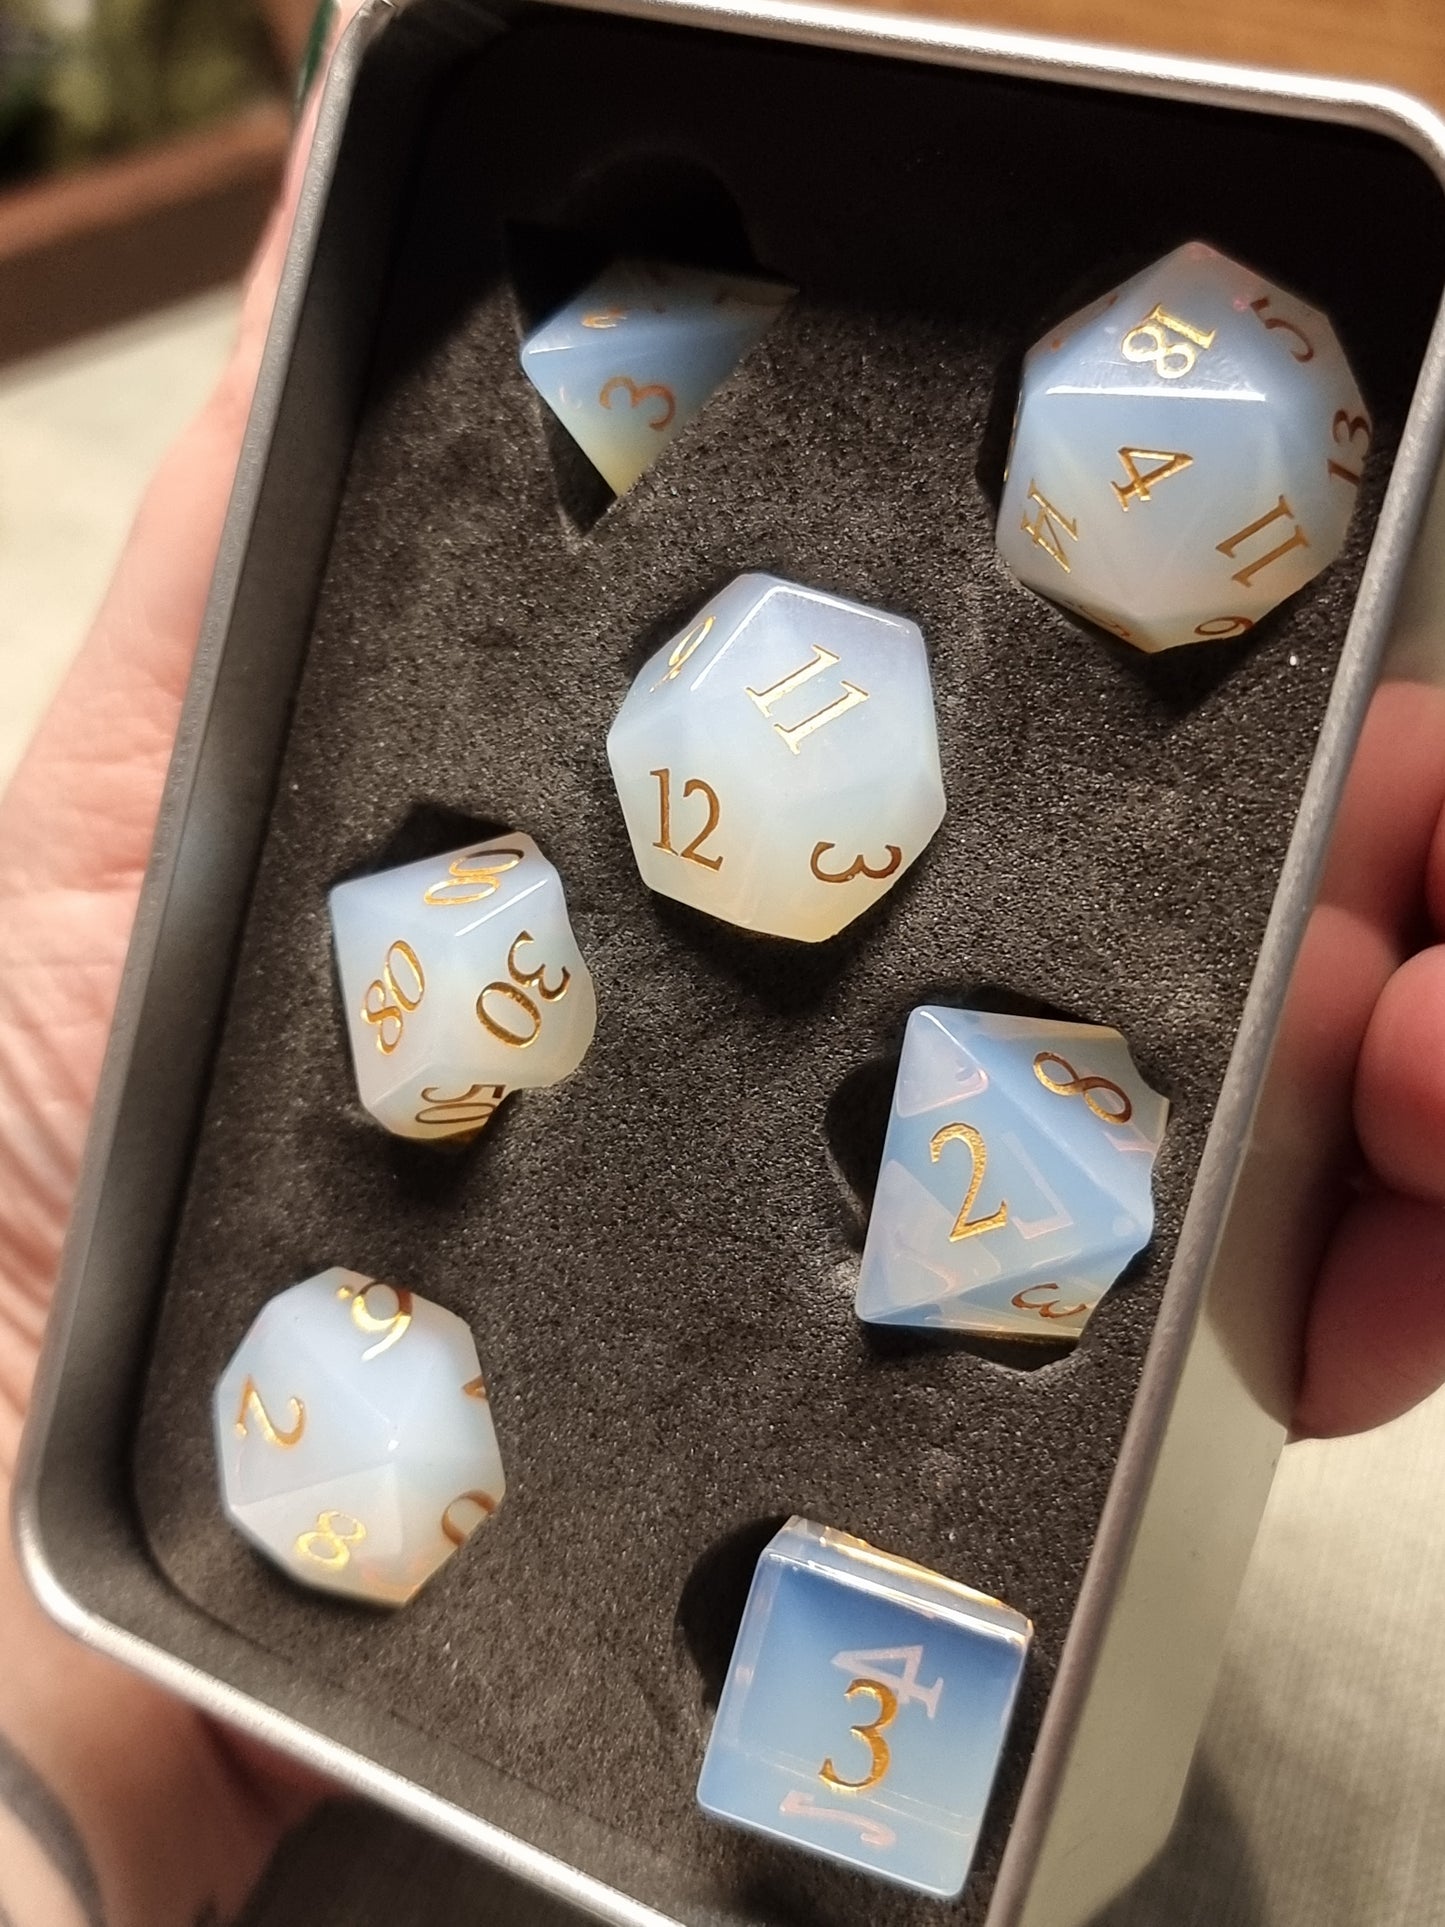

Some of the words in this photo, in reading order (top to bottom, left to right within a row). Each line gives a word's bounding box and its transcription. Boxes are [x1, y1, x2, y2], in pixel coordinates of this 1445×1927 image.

[1121, 303, 1217, 379] 18
[599, 376, 676, 431] 3
[1110, 446, 1194, 512] 4
[1214, 494, 1310, 588] 11
[745, 644, 869, 755] 11
[649, 768, 723, 872] 12
[810, 842, 902, 883] 3
[424, 849, 525, 905] 00
[361, 940, 425, 1056] 80
[476, 930, 571, 1049] 30
[1032, 1051, 1132, 1124] 8
[929, 1122, 1008, 1242] 2
[295, 1510, 367, 1571] 8
[818, 1678, 898, 1792] 3
